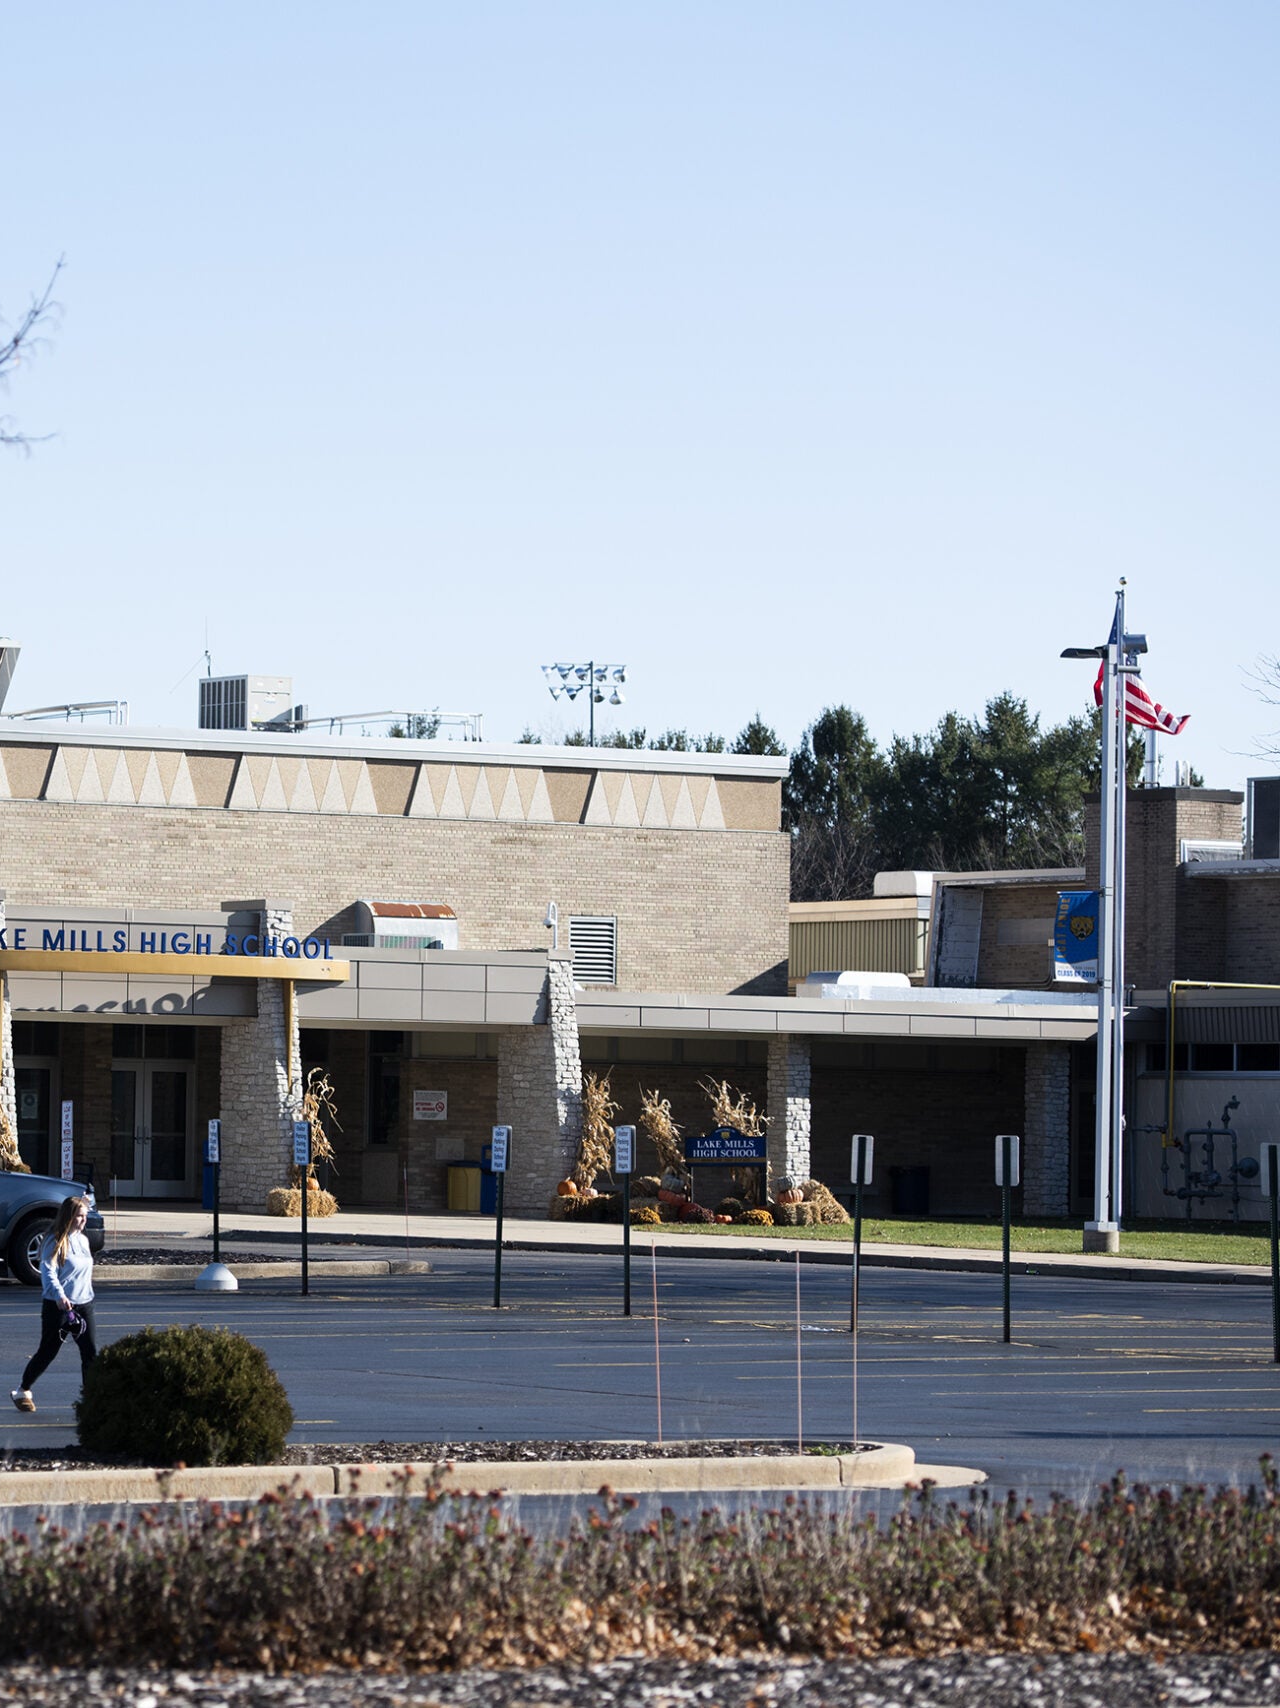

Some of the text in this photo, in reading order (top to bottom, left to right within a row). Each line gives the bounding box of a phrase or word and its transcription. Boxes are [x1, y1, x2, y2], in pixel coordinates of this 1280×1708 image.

[1057, 898, 1071, 927] PRIDE
[42, 929, 126, 953] MILLS
[140, 931, 212, 956] HIGH
[224, 934, 334, 960] SCHOOL
[1057, 969, 1074, 977] CLASS
[1082, 970, 1096, 978] 2019
[697, 1140, 754, 1148] LAKE MILLS
[692, 1149, 759, 1157] HIGH SCHOOL
